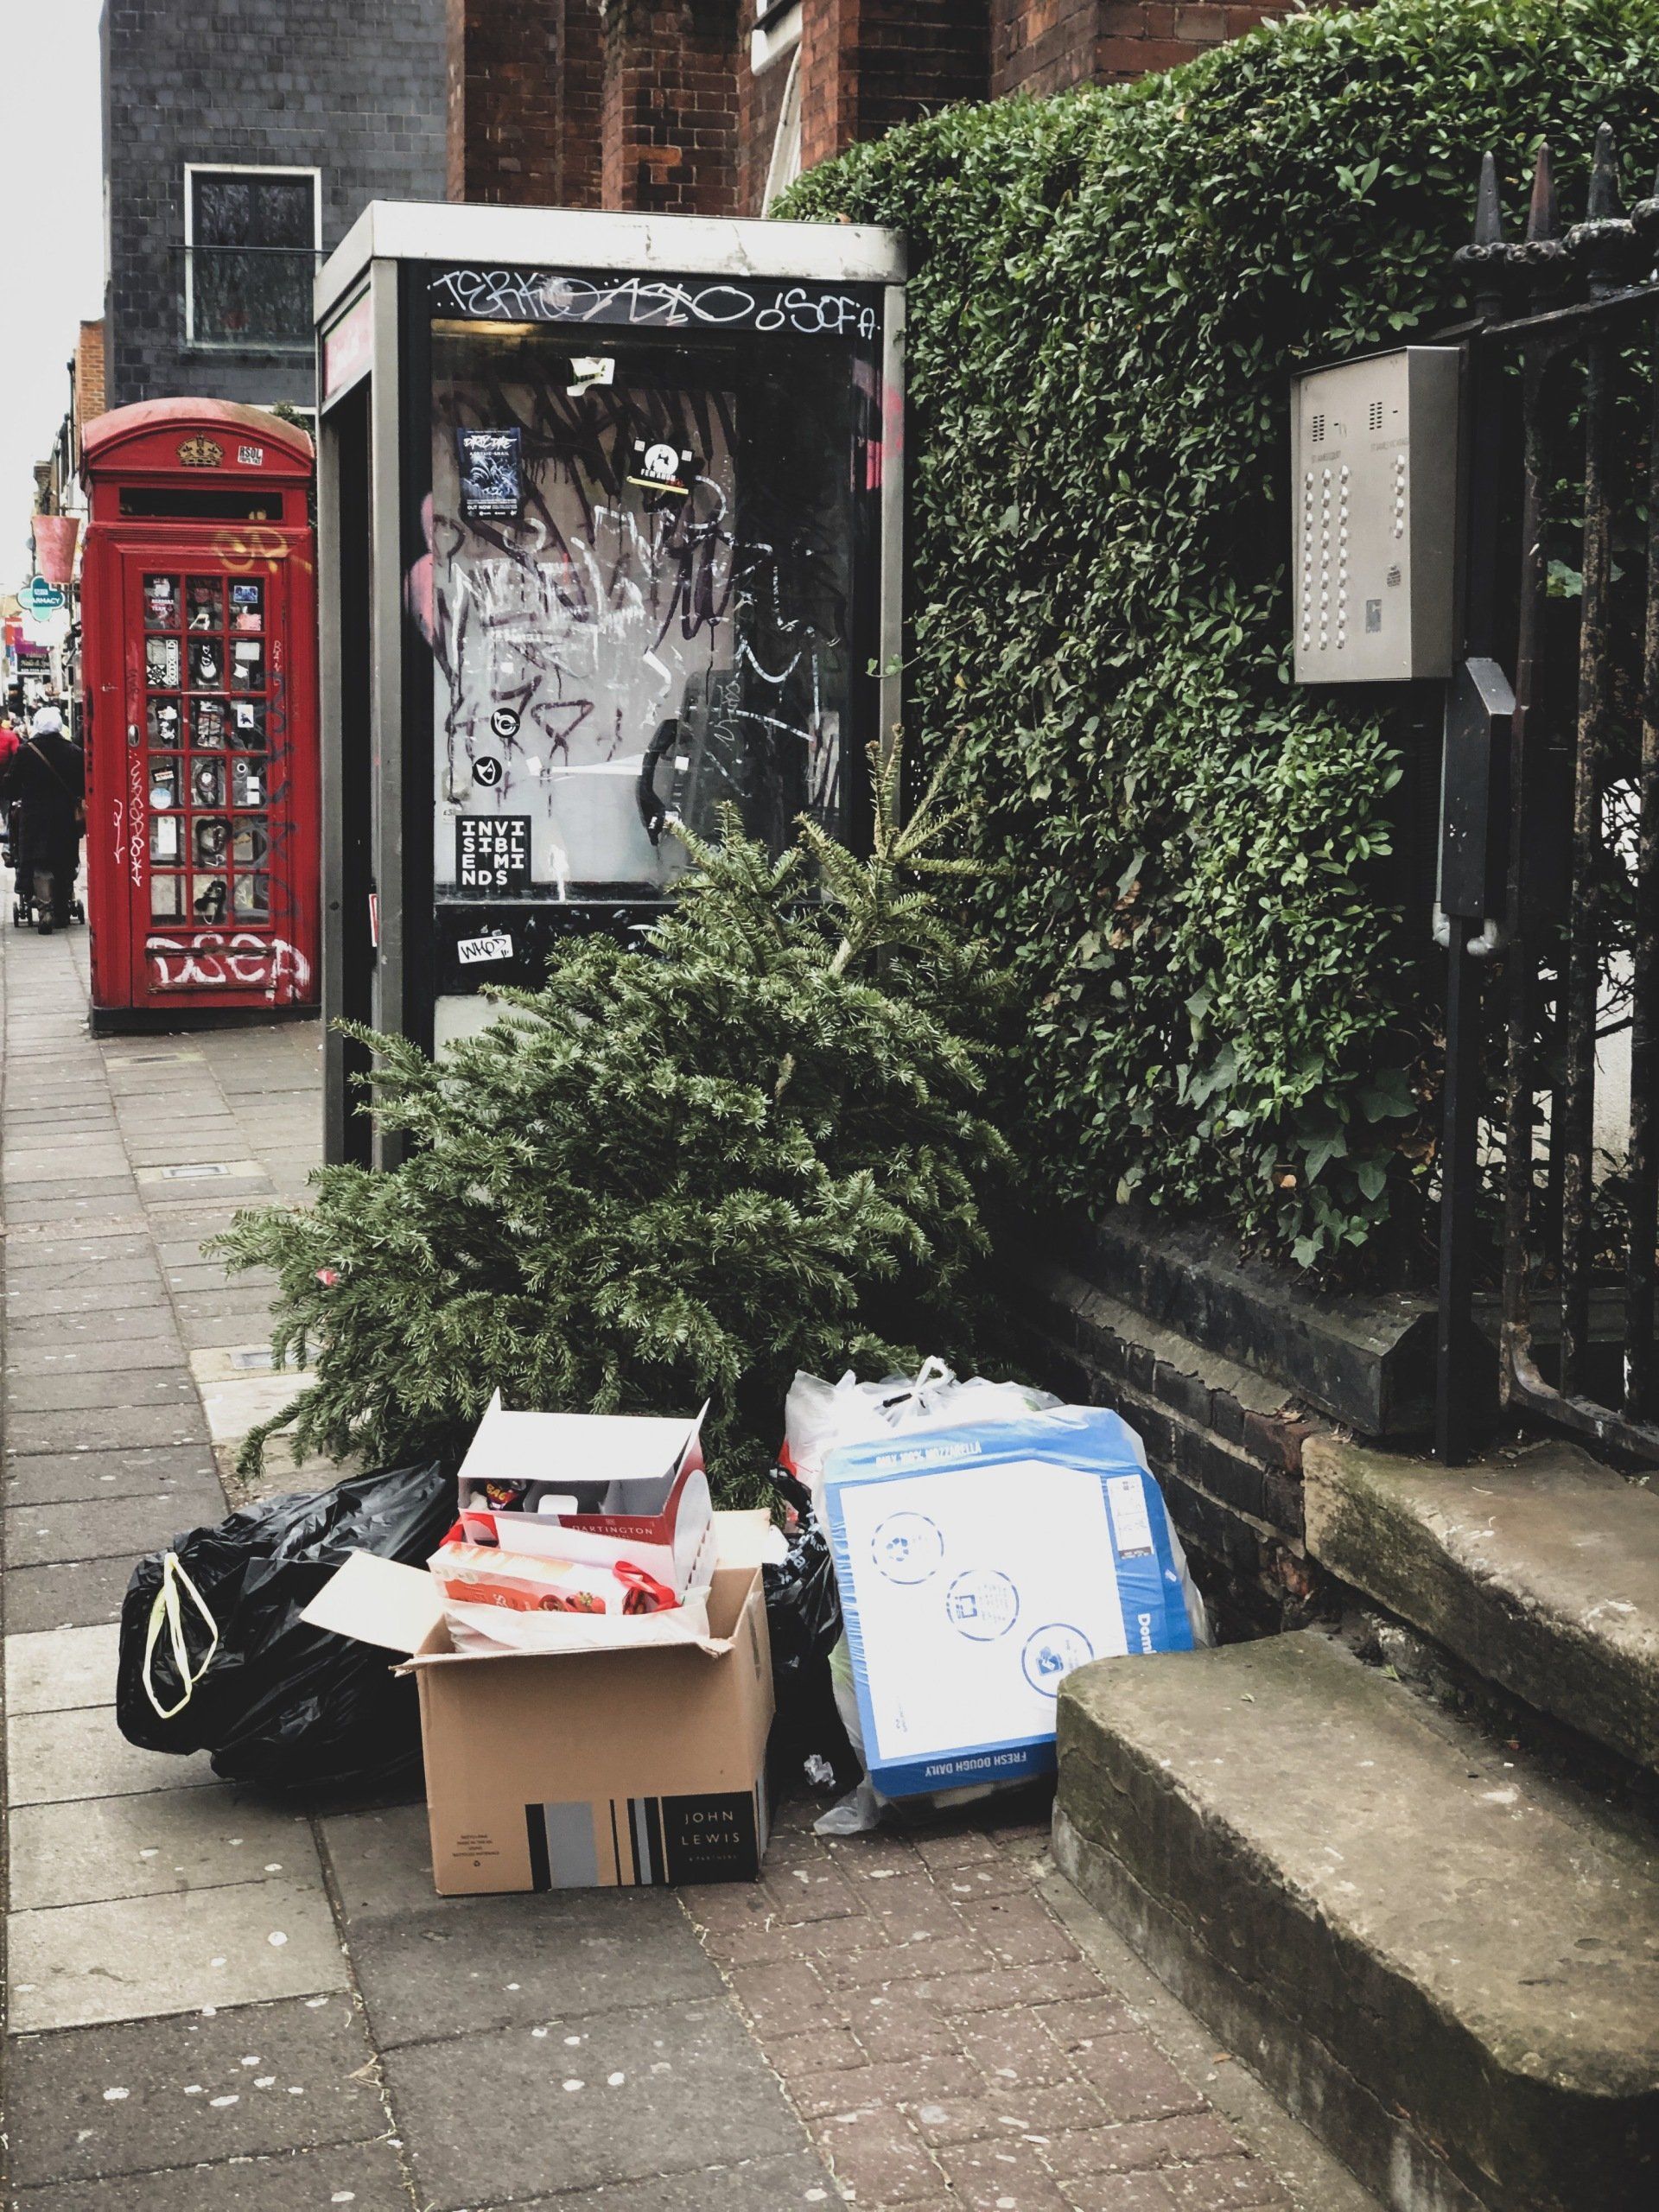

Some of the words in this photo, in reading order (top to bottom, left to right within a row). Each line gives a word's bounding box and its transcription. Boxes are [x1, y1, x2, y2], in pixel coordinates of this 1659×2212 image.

[461, 821, 524, 836] INVI
[461, 837, 524, 853] SIBL
[461, 870, 508, 886] NDS
[572, 1524, 654, 1535] DARTINGTON
[955, 1757, 992, 1773] DOUGH
[994, 1751, 1027, 1766] FRESH
[925, 1763, 954, 1777] DAILY
[685, 1810, 734, 1825] JOHN
[681, 1832, 741, 1846] LEWIS
